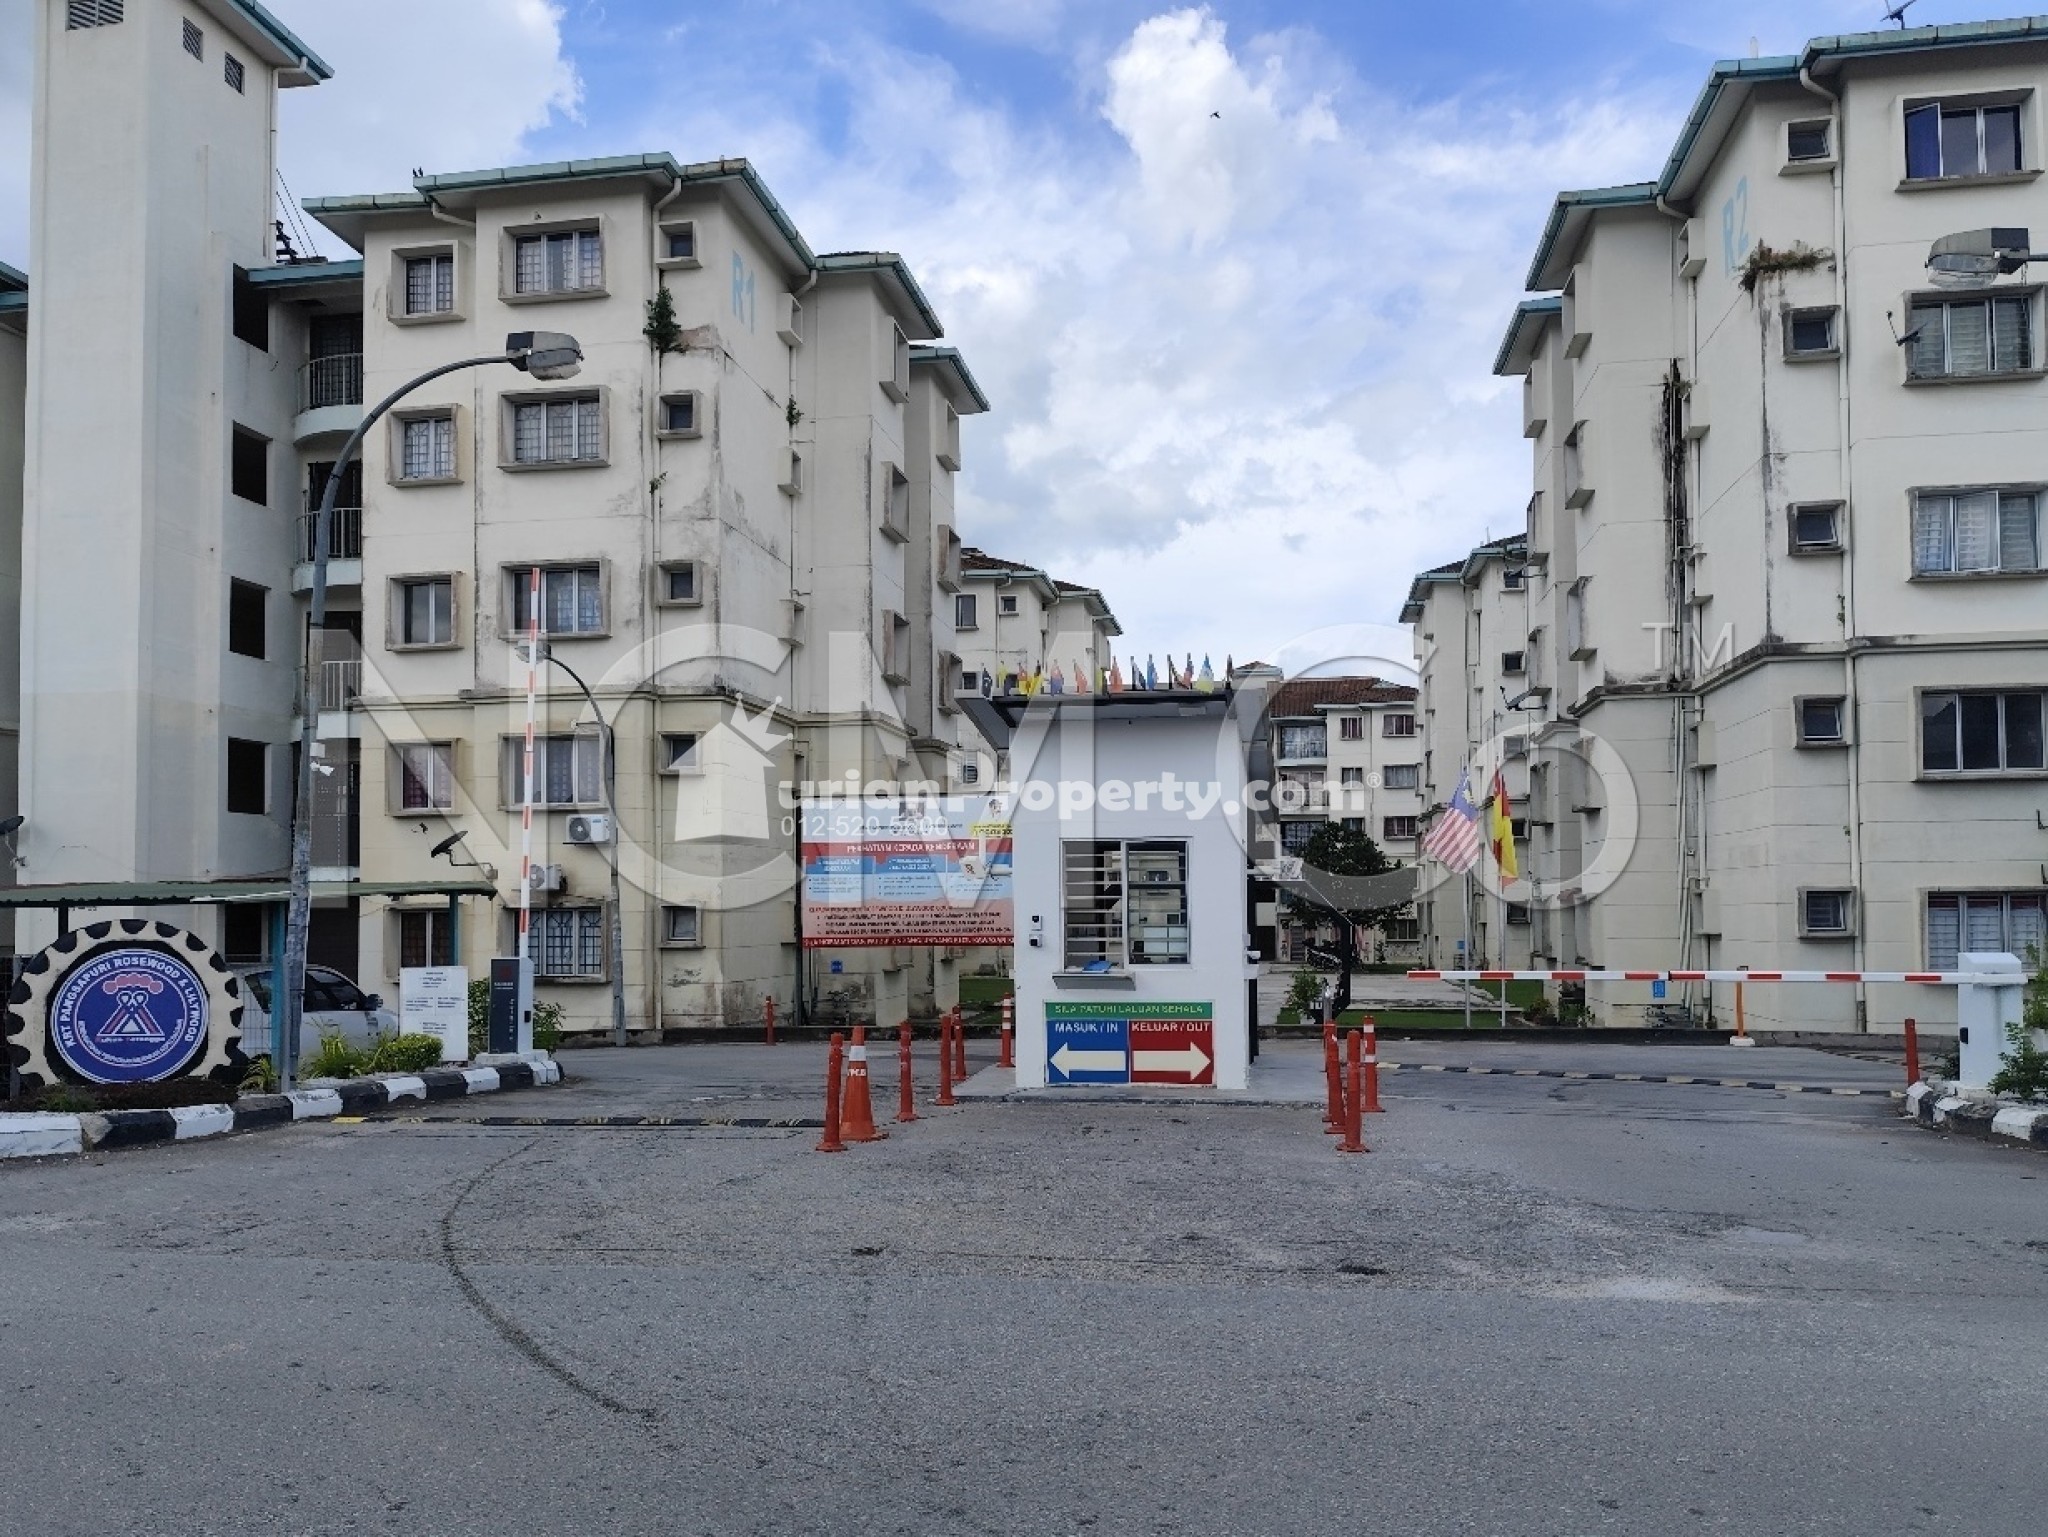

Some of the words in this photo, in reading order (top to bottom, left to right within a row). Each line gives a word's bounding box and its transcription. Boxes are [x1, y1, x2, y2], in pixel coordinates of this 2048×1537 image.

[1723, 174, 1749, 277] R2
[731, 248, 755, 336] R1
[60, 963, 111, 1022] PANGSAPURI
[113, 957, 181, 979] ROSEWOOD
[1055, 1005, 1077, 1014] SILA
[1079, 1005, 1117, 1014] PATUHI
[1118, 1005, 1160, 1014] LALUAN
[1161, 1005, 1204, 1014] SEHALA
[1055, 1023, 1098, 1034] MASUK
[1106, 1023, 1118, 1034] IN
[1131, 1022, 1179, 1033] KELUAR
[1186, 1022, 1210, 1033] OUT
